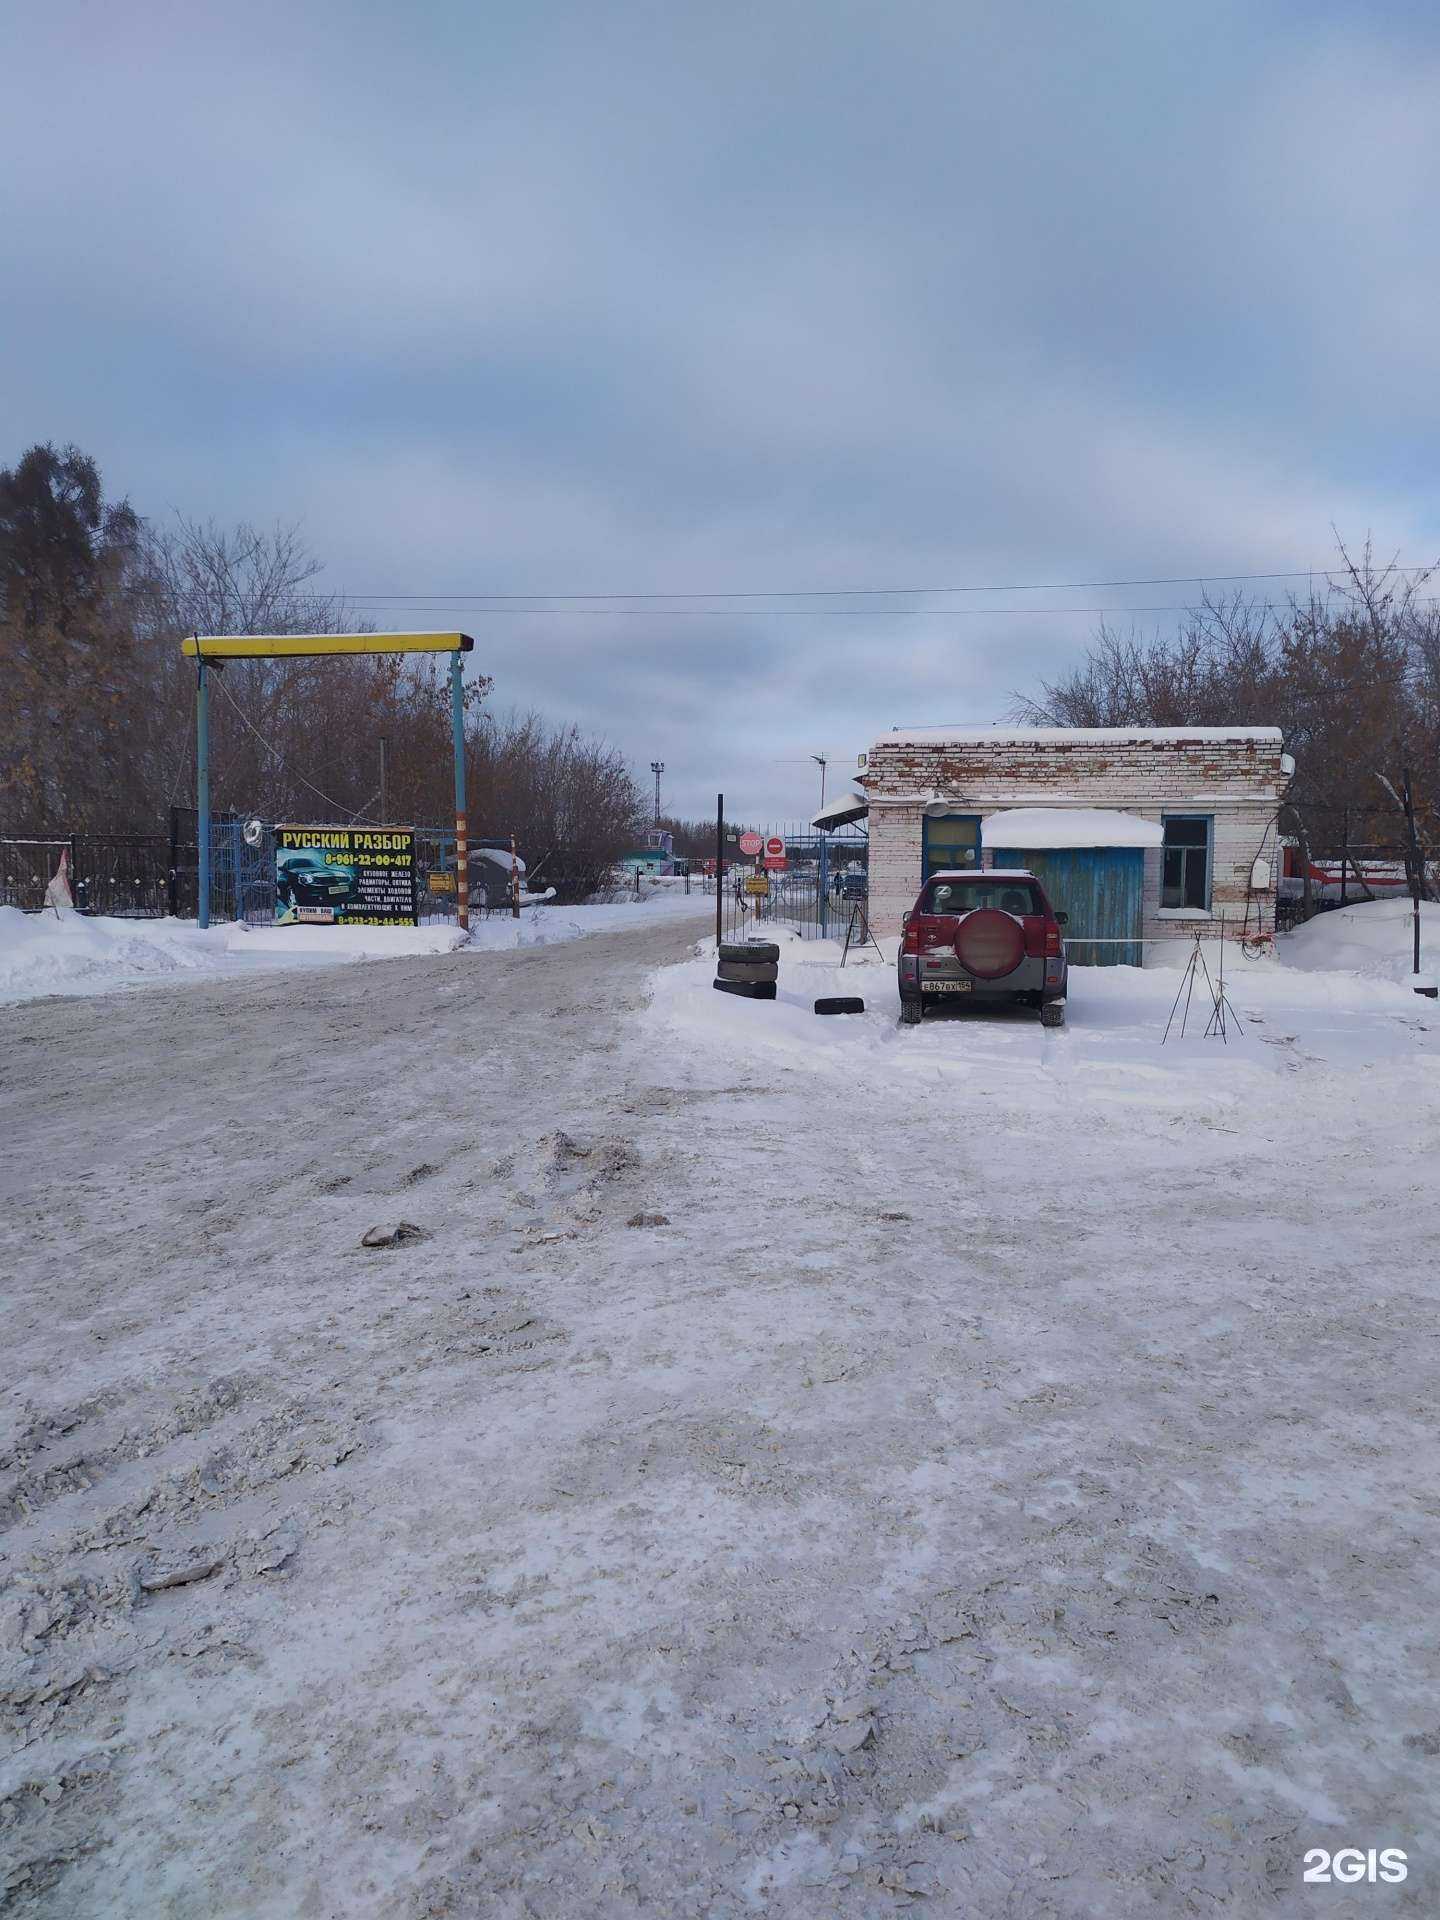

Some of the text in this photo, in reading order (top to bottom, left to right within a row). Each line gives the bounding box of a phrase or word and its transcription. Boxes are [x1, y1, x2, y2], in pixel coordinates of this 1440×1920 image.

[282, 832, 411, 850] РУССКИЙ РАЗБОР
[742, 840, 760, 849] STOP
[325, 853, 412, 866] 8-961-22-00-417
[363, 870, 411, 878] КУЗОВОЕ ЖЕЛЕЗО
[357, 886, 412, 895] ЭЛЕМЕНТЫ ХОДОВОЙ
[347, 903, 392, 911] КОМПЛЕКТУЮЩИЕ
[400, 904, 413, 912] НИМ
